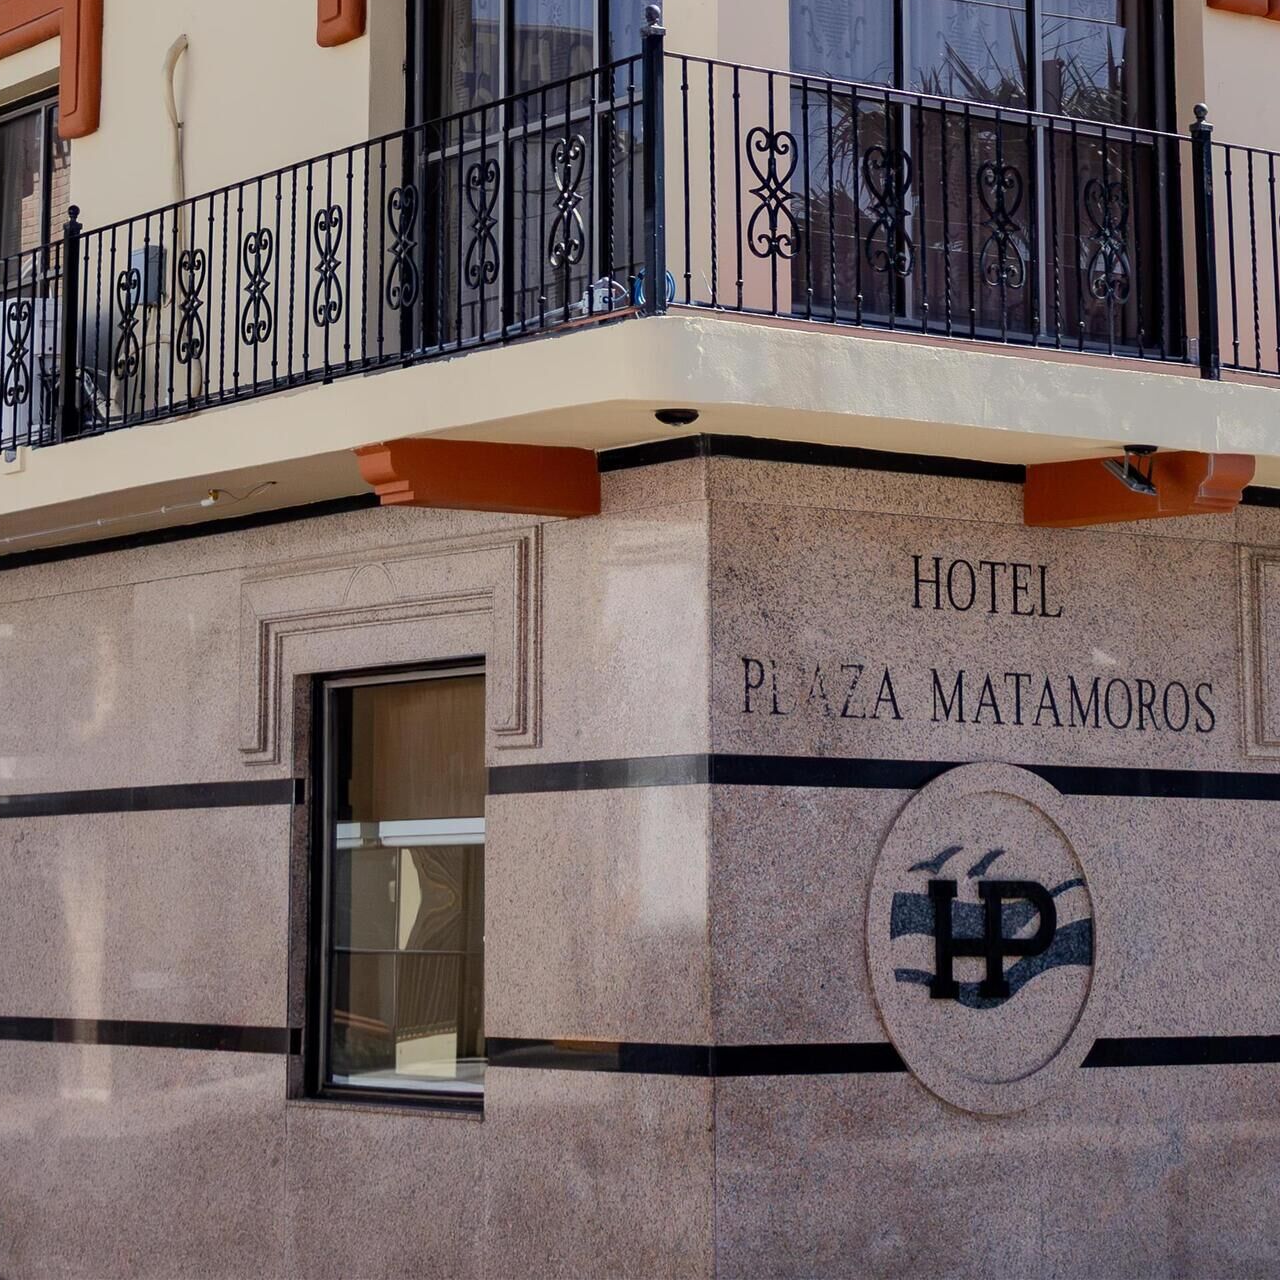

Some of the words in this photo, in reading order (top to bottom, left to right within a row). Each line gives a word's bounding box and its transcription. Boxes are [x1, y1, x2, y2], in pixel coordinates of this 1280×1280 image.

[912, 555, 1063, 618] HOTEL
[929, 667, 1217, 733] MATAMOROS
[928, 880, 1057, 999] HP
